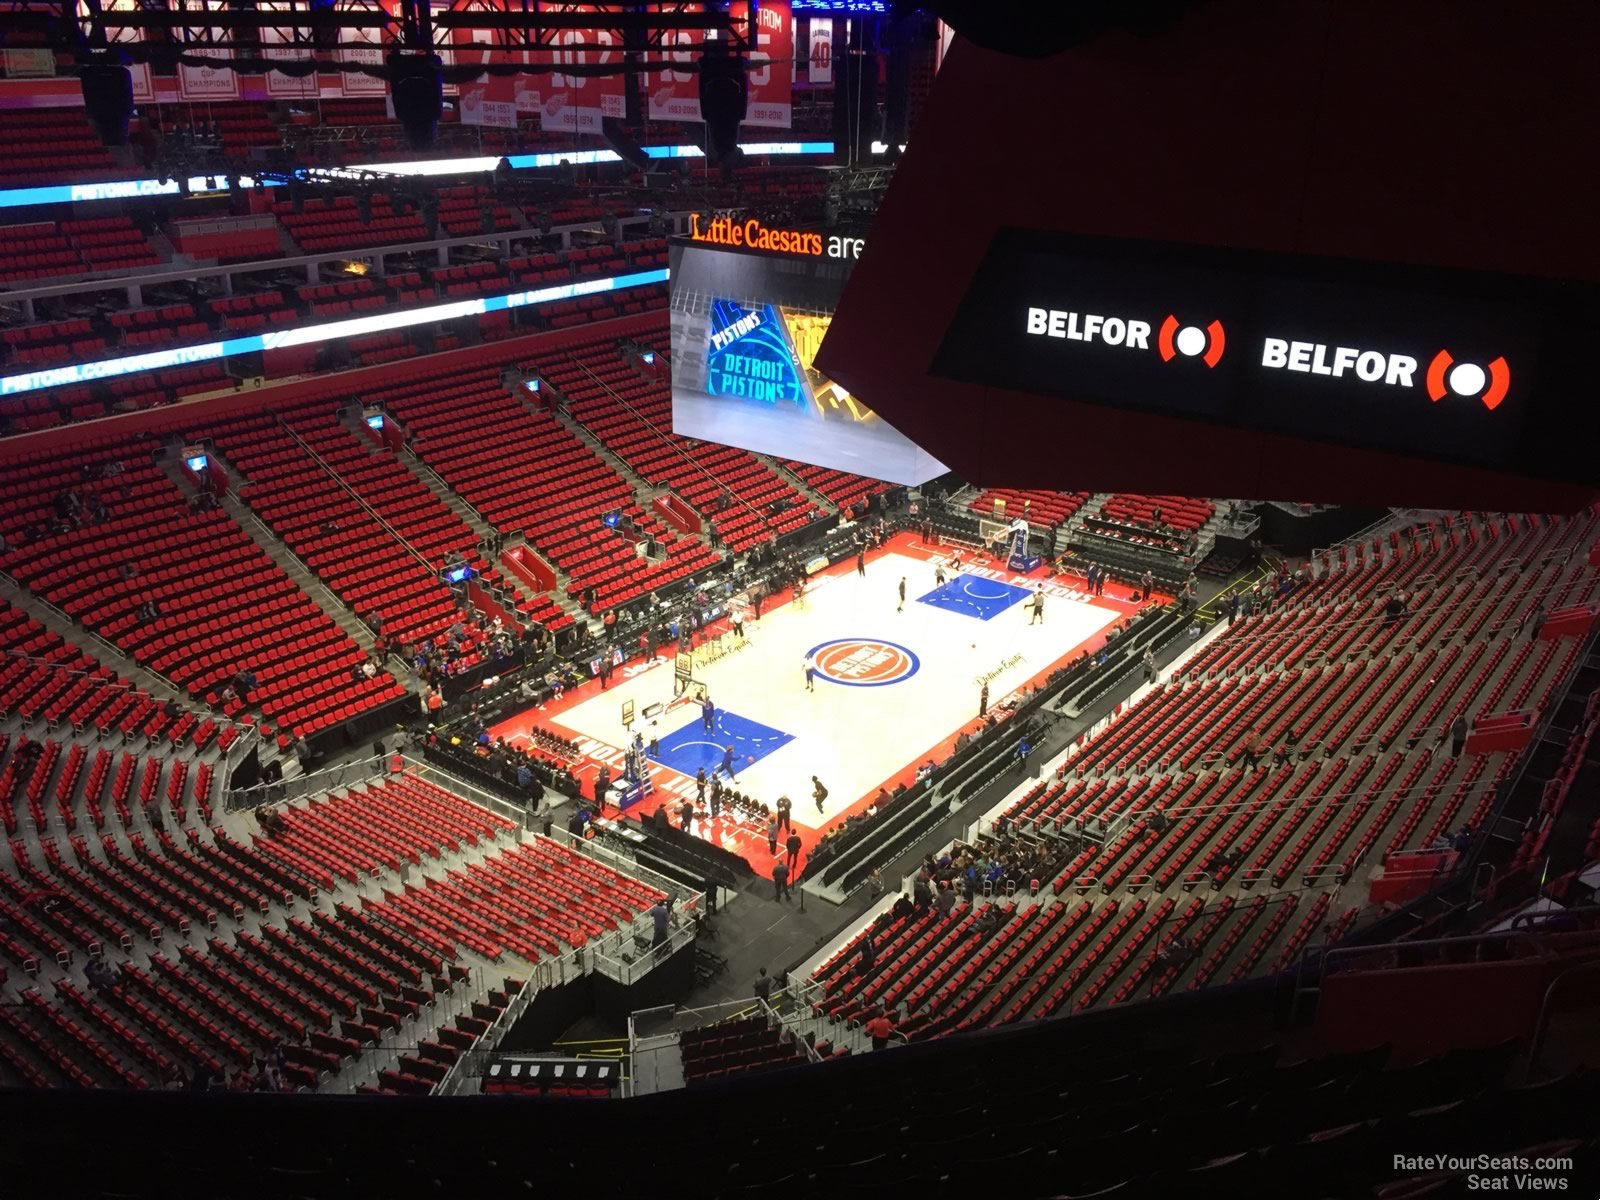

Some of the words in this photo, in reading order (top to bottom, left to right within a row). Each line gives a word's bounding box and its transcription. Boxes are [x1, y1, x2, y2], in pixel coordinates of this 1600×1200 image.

[811, 42, 830, 69] 40
[188, 80, 231, 88] CHAMPIONS
[272, 78, 313, 86] CHAMPIONS
[754, 110, 784, 121] 1991-2012
[744, 219, 823, 256] Caesars
[711, 311, 761, 351] PISTONS
[1026, 307, 1152, 349] BELFOR
[725, 353, 785, 382] DETROIT
[1261, 337, 1418, 388] BELFOR
[721, 373, 785, 403] PISTONS
